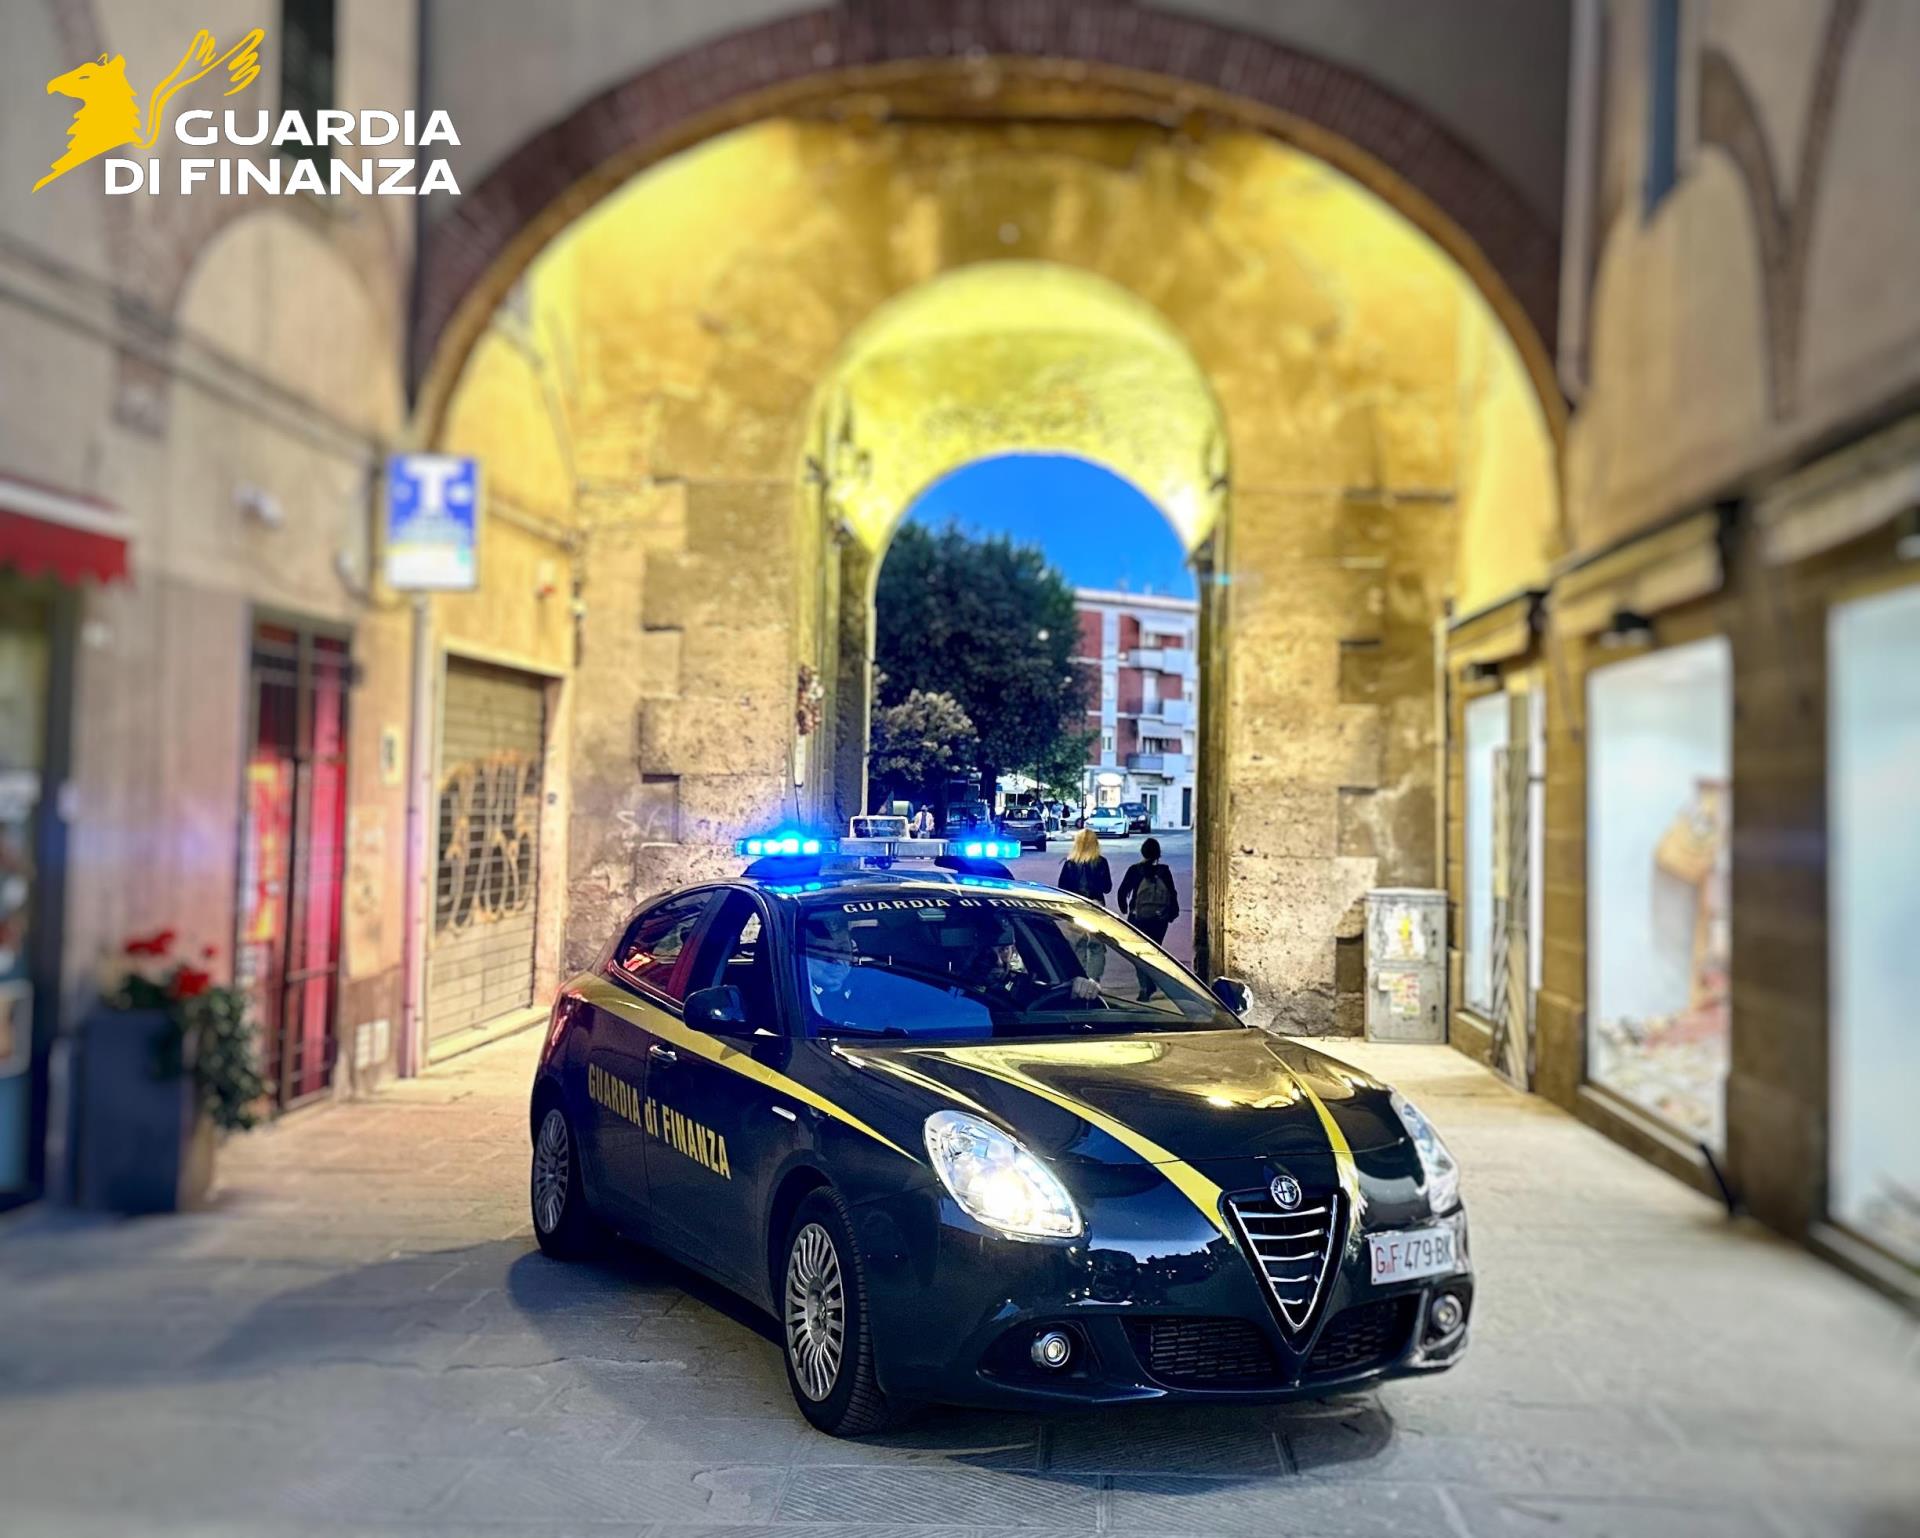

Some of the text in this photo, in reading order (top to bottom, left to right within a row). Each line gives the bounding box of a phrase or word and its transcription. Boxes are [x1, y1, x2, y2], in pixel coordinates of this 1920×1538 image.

[842, 899, 950, 913] GUARDIA
[959, 899, 982, 907] di
[588, 1062, 732, 1180] GUARDIA di FINANZA
